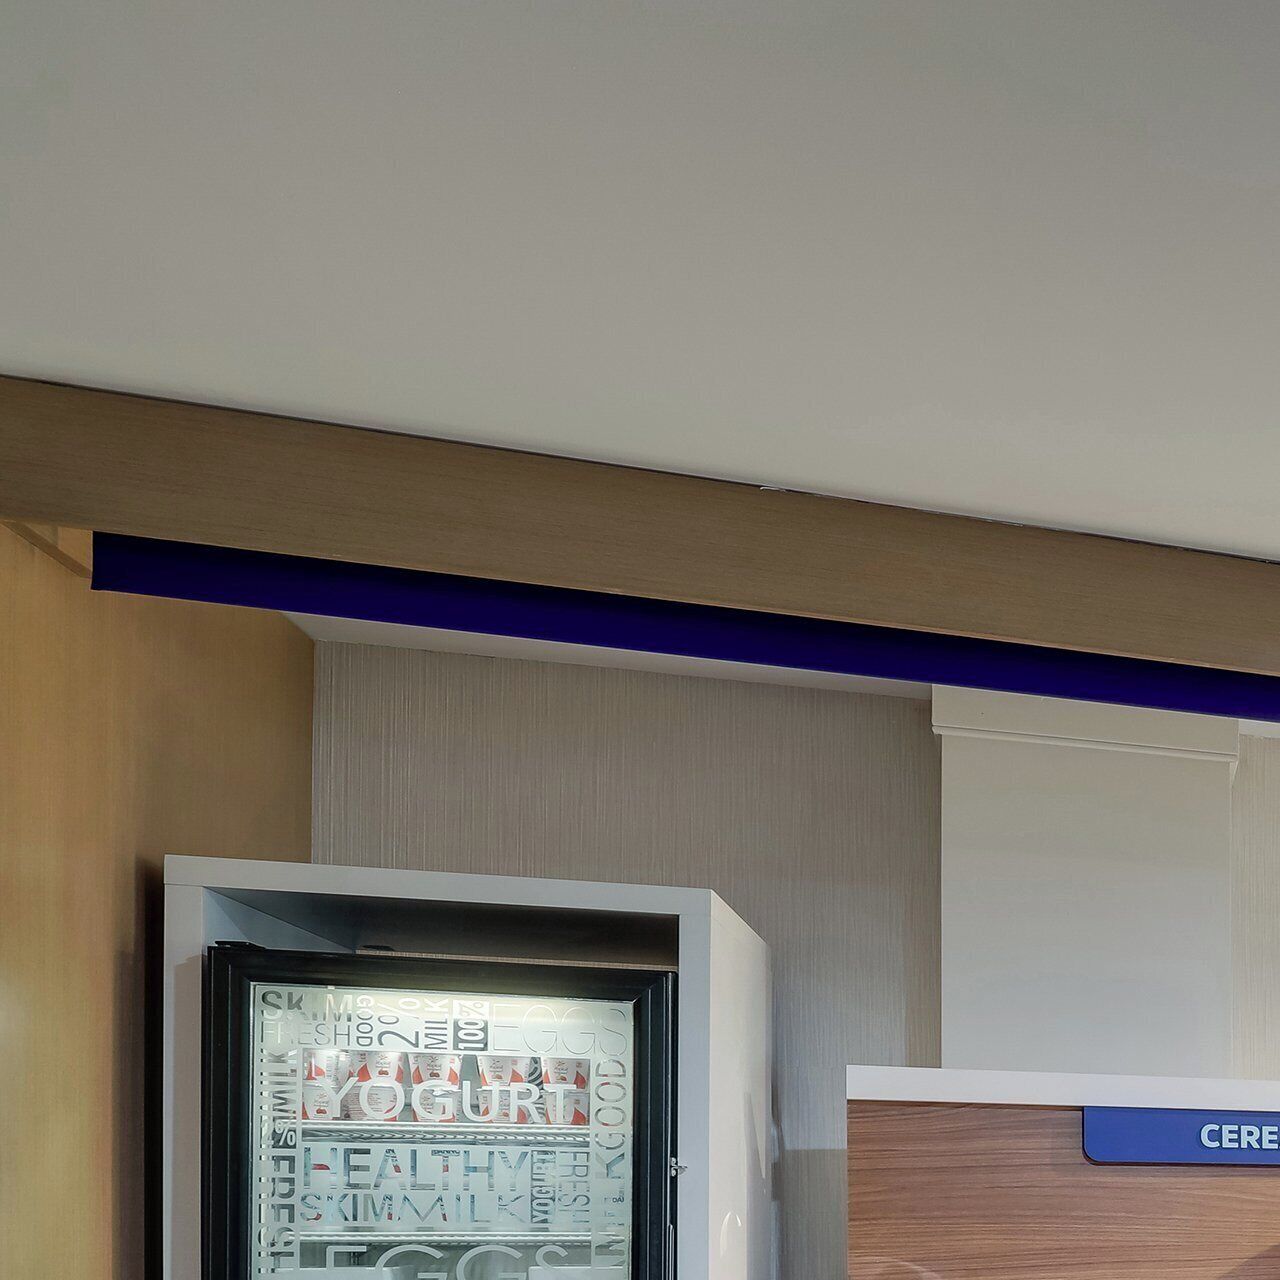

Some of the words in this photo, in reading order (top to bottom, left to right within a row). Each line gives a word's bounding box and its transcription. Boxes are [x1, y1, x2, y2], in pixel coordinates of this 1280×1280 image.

[261, 1021, 350, 1046] FESH
[424, 997, 448, 1049] MILK
[493, 1004, 628, 1056] EGGS
[314, 1077, 577, 1122] YOGURT
[594, 1059, 627, 1150] GOOD
[304, 1147, 530, 1191] HEALTHY
